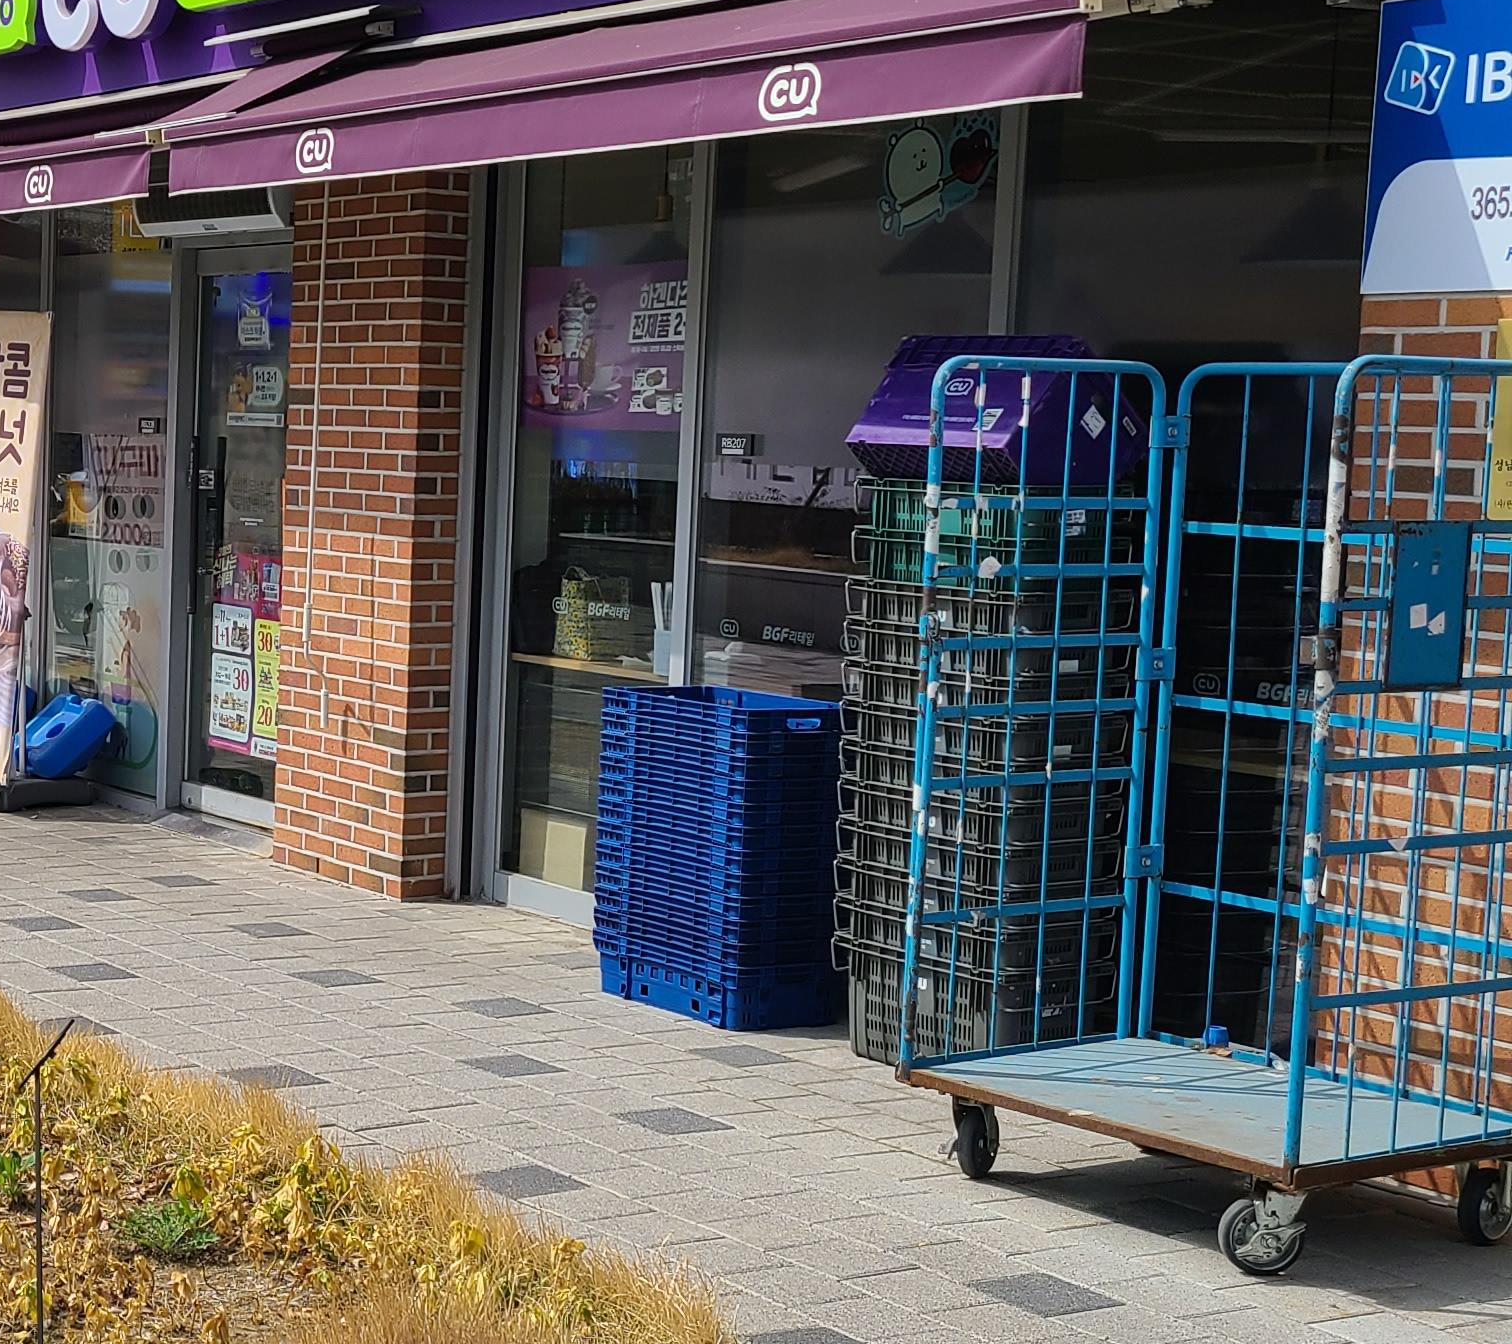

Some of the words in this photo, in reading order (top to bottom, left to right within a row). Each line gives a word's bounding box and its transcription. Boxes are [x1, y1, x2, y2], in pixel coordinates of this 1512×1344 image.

[769, 76, 810, 108] CU
[302, 138, 328, 163] CU
[29, 174, 48, 195] CU
[632, 312, 671, 340] 전제품
[949, 381, 970, 391] CU
[721, 437, 747, 449] RB207
[587, 601, 631, 621] BGF리테일
[257, 630, 273, 652] 30
[762, 625, 816, 648] BGF리테일
[232, 667, 249, 692] 30
[257, 704, 273, 727] 20
